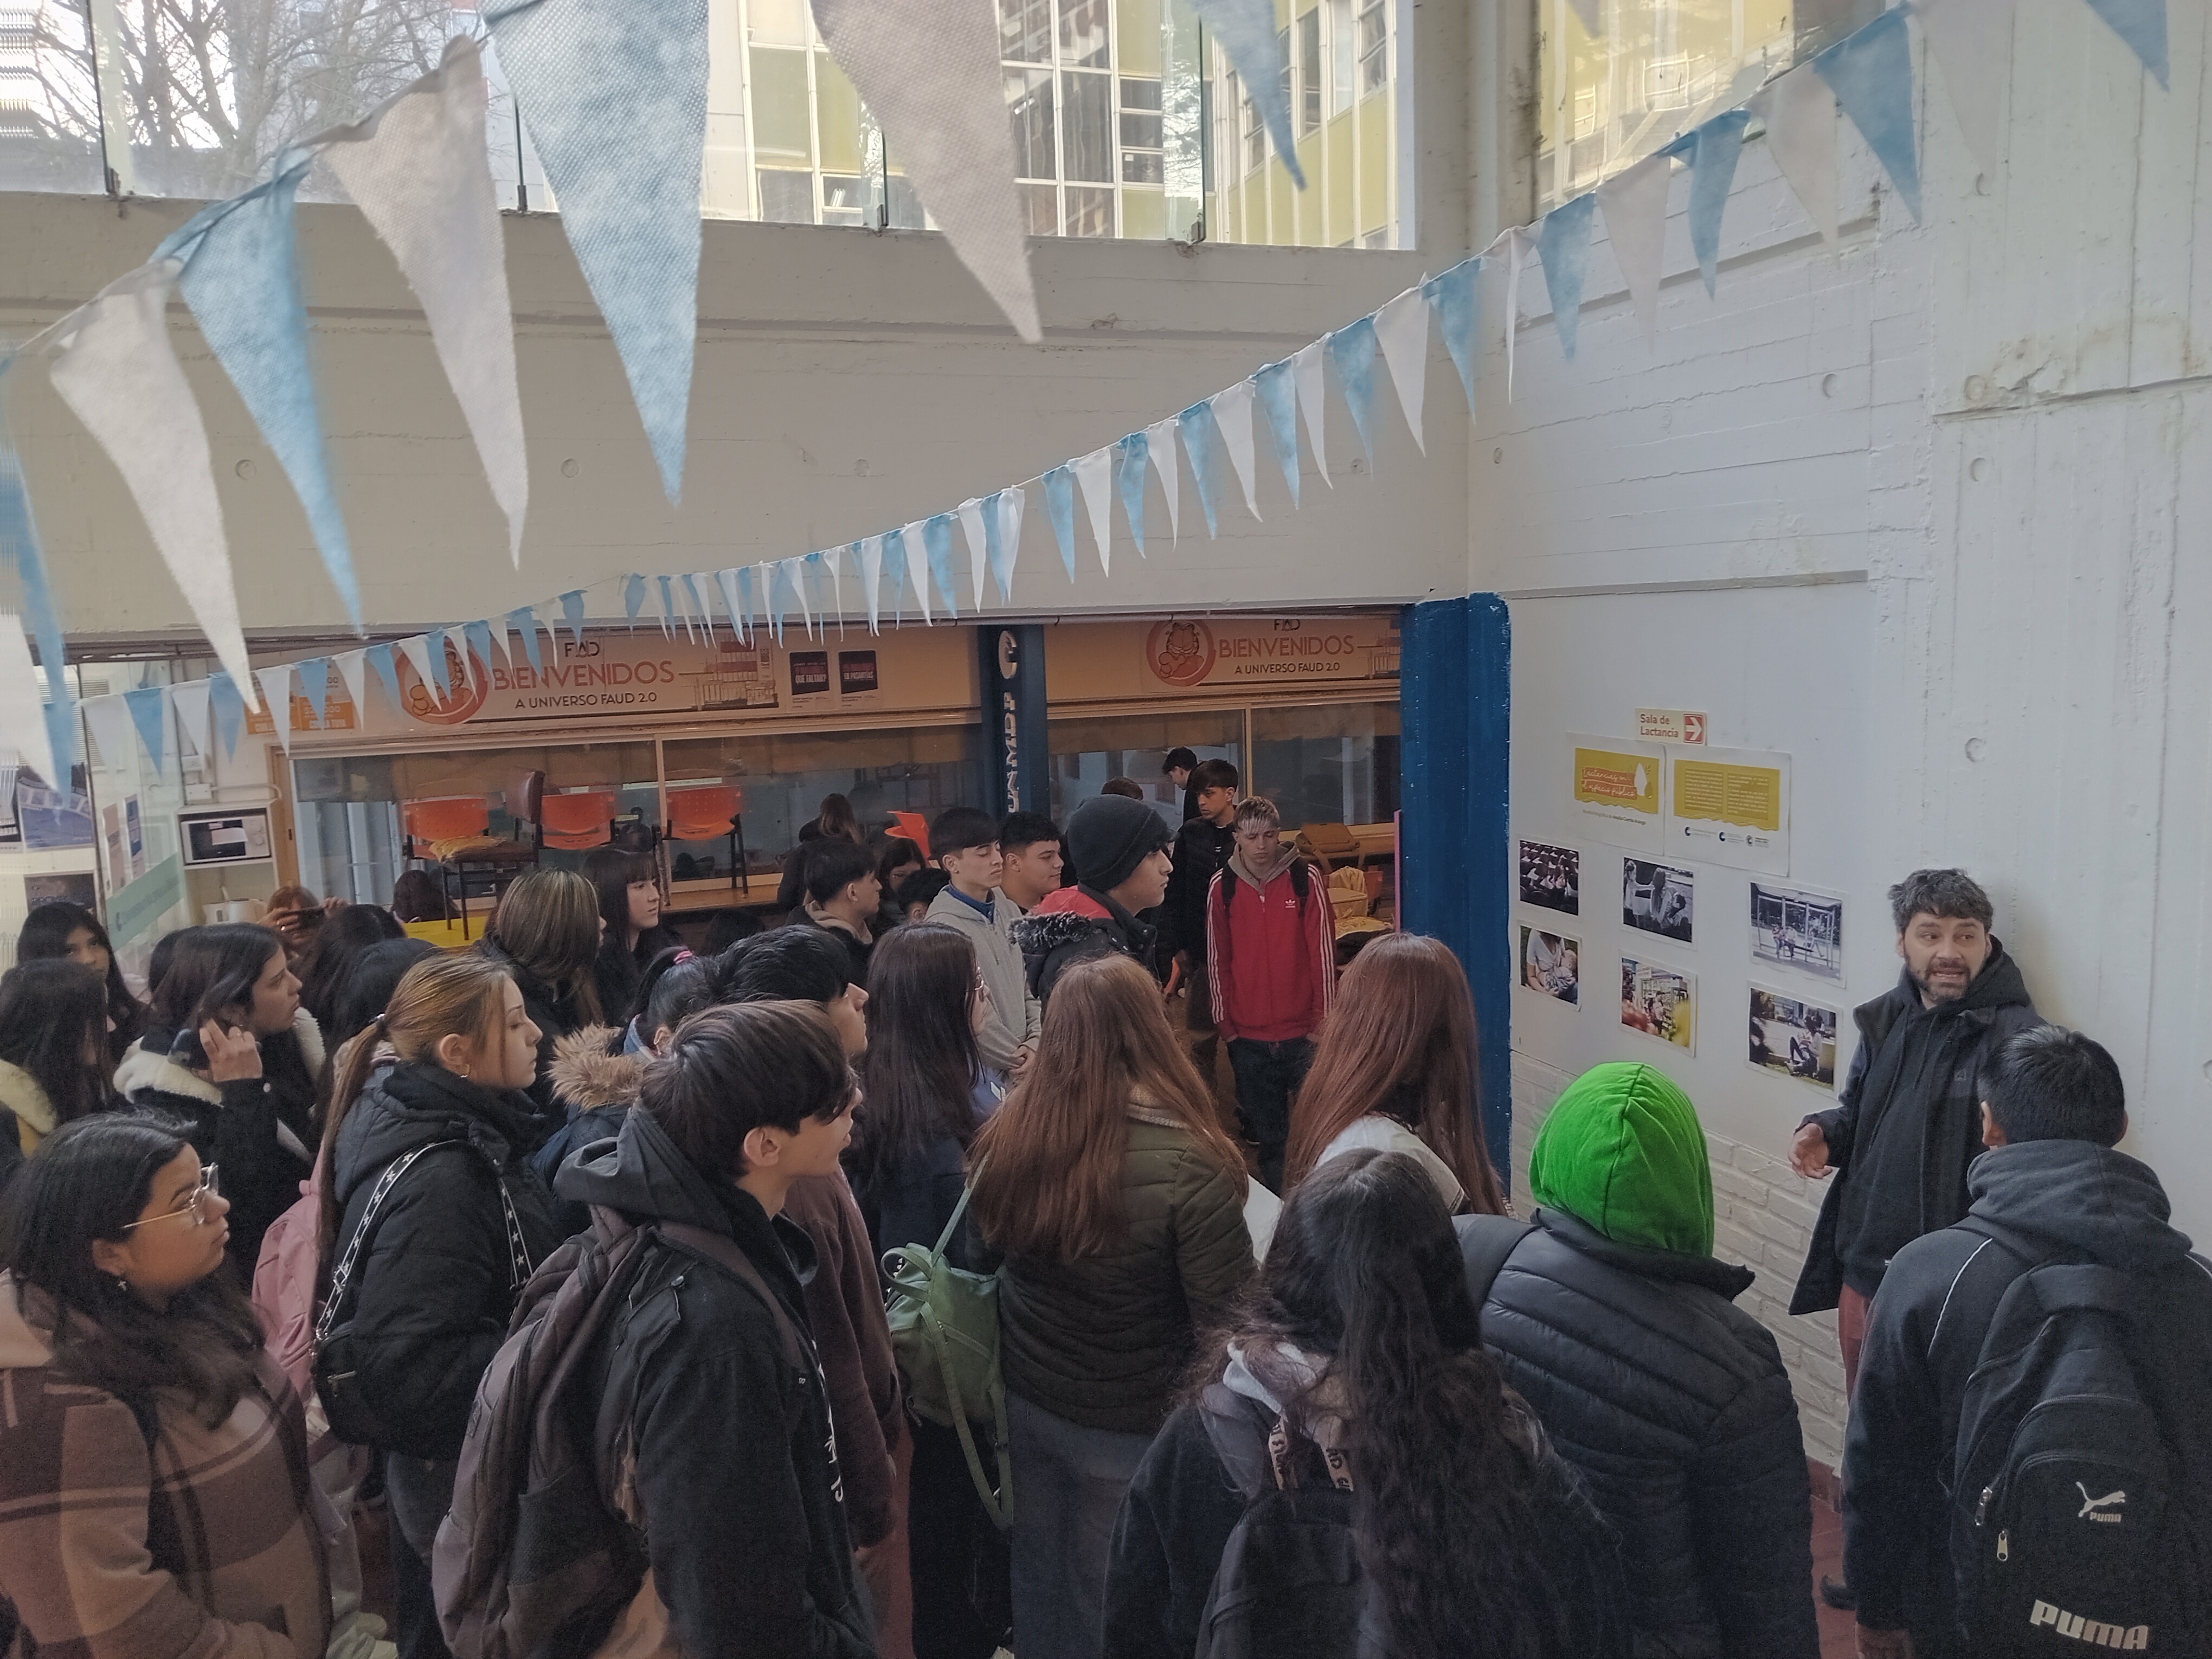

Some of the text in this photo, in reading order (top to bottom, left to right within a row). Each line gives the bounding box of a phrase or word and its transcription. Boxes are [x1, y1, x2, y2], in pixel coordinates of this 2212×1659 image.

[1219, 635, 1354, 658] BIENVENIDOS
[492, 660, 674, 690] BIENVENIDOS
[1234, 662, 1340, 674] A UNIVERSO FAUD 2.0
[515, 692, 657, 709] A UNIVERSO FAUD 2.0
[1640, 713, 1670, 725] Sala de
[1640, 725, 1679, 738] Lactancia
[2089, 1511, 2122, 1523] PUMA
[2029, 1599, 2149, 1650] PUMA
